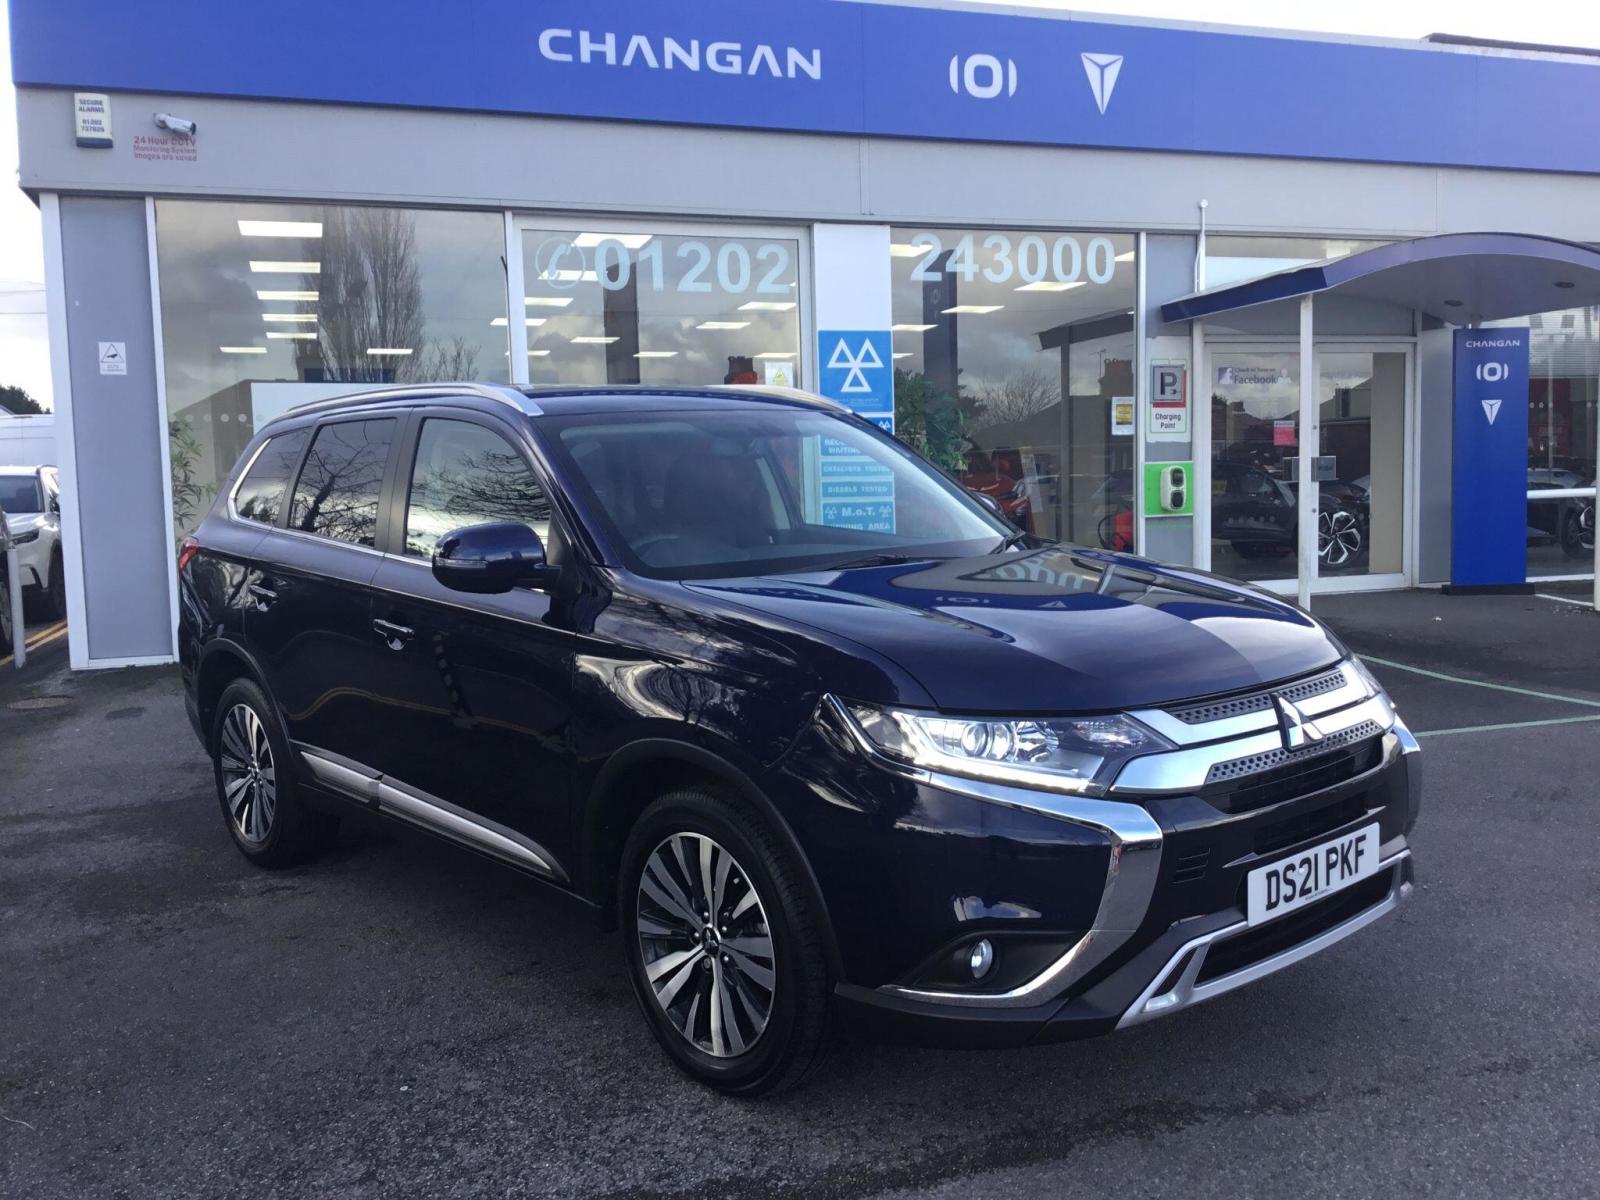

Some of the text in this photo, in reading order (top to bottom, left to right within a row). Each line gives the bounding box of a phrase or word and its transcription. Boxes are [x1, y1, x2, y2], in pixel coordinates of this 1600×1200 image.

[538, 28, 821, 80] CHANGAN
[133, 135, 197, 147] 24 Hour CCTV
[133, 145, 197, 155] Monitoring System
[910, 232, 1116, 284] 243000
[594, 238, 791, 294] 01202
[1465, 339, 1520, 348] CHANGAN
[1160, 372, 1177, 395] P
[1234, 374, 1278, 385] Facebook
[1154, 412, 1181, 421] Charging
[1160, 421, 1176, 429] Point
[841, 506, 876, 516] M.o.T.
[868, 522, 891, 530] AREA
[1265, 833, 1367, 912] DS21 PKF
